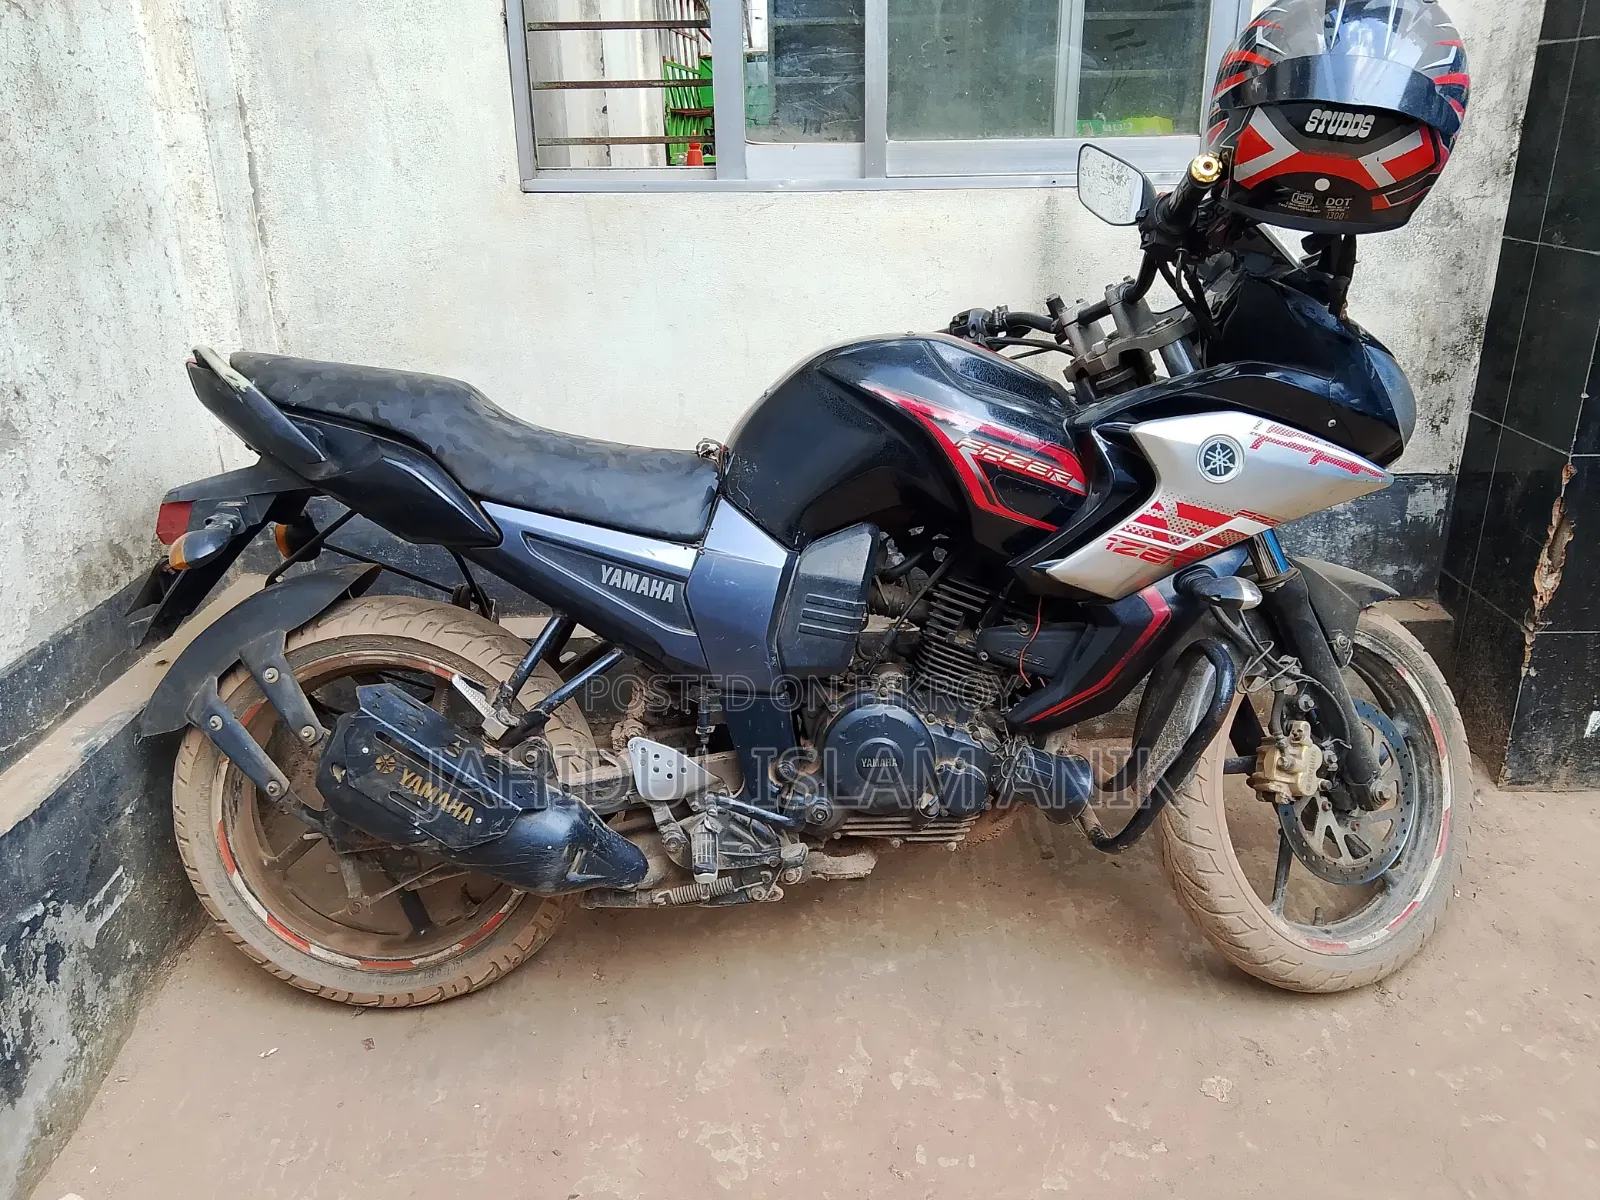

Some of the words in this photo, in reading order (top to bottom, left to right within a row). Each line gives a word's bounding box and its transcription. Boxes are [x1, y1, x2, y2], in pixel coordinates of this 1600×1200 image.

[1305, 108, 1375, 138] STUDDS
[1325, 197, 1353, 206] DOT
[955, 437, 1072, 485] FAZER
[601, 564, 675, 603] YAMAHA
[861, 758, 898, 768] YAMAHA
[398, 766, 476, 826] YAMAHA
